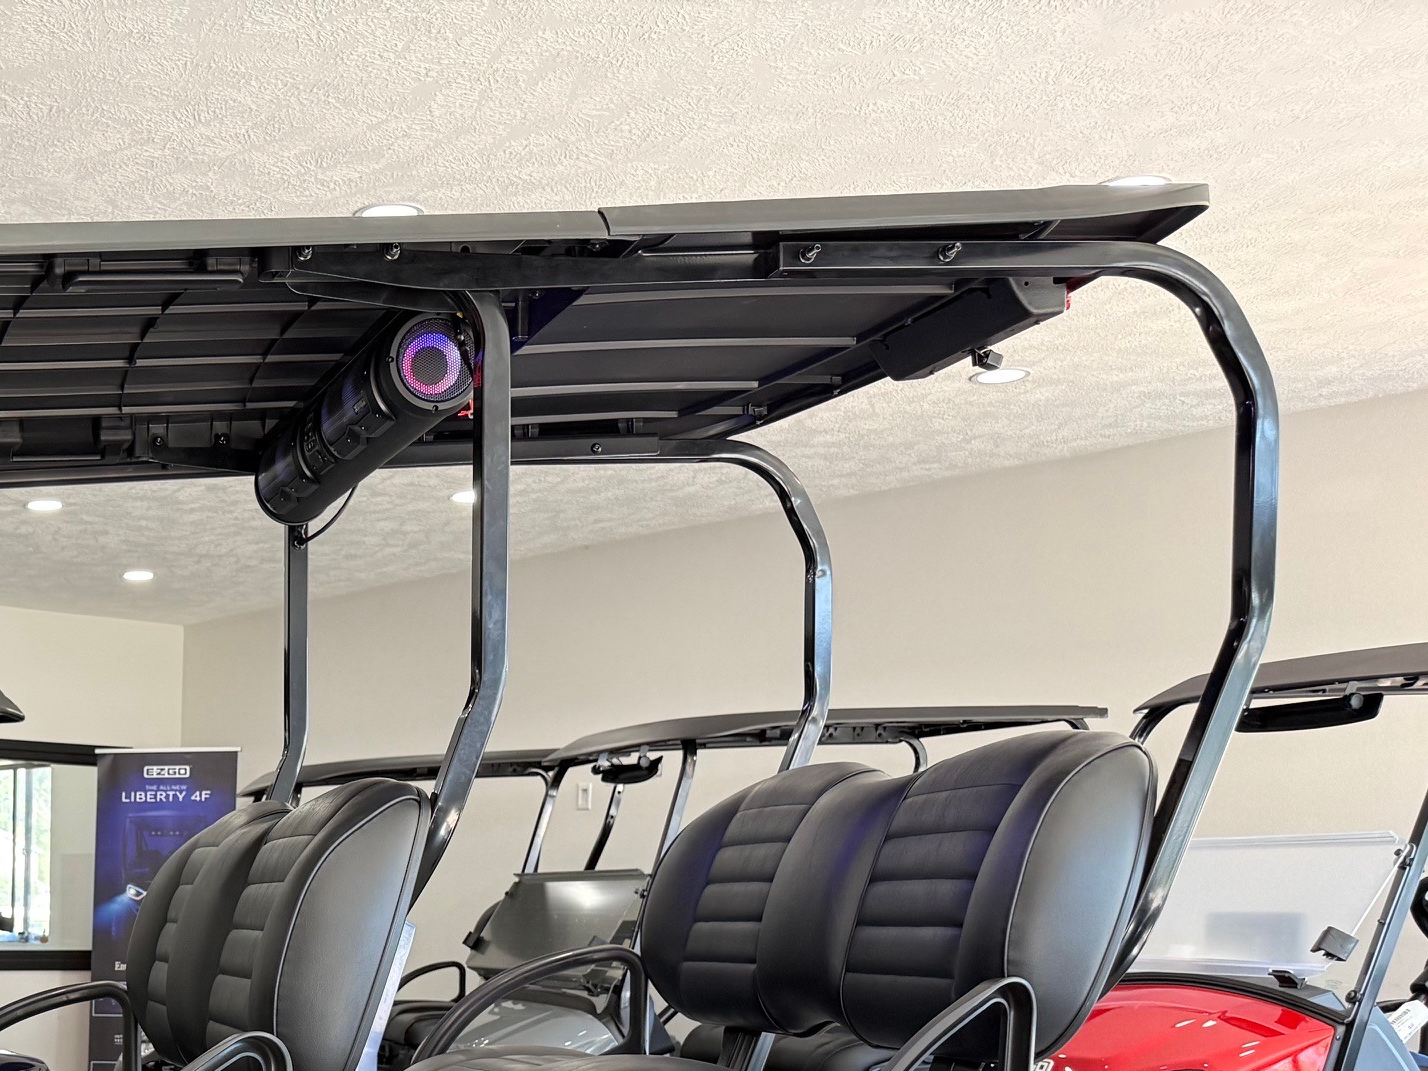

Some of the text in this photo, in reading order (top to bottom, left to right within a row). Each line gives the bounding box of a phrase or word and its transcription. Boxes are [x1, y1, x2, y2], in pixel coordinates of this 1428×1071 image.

[145, 767, 188, 777] EZGO
[121, 790, 212, 802] LIBERTY 4F
